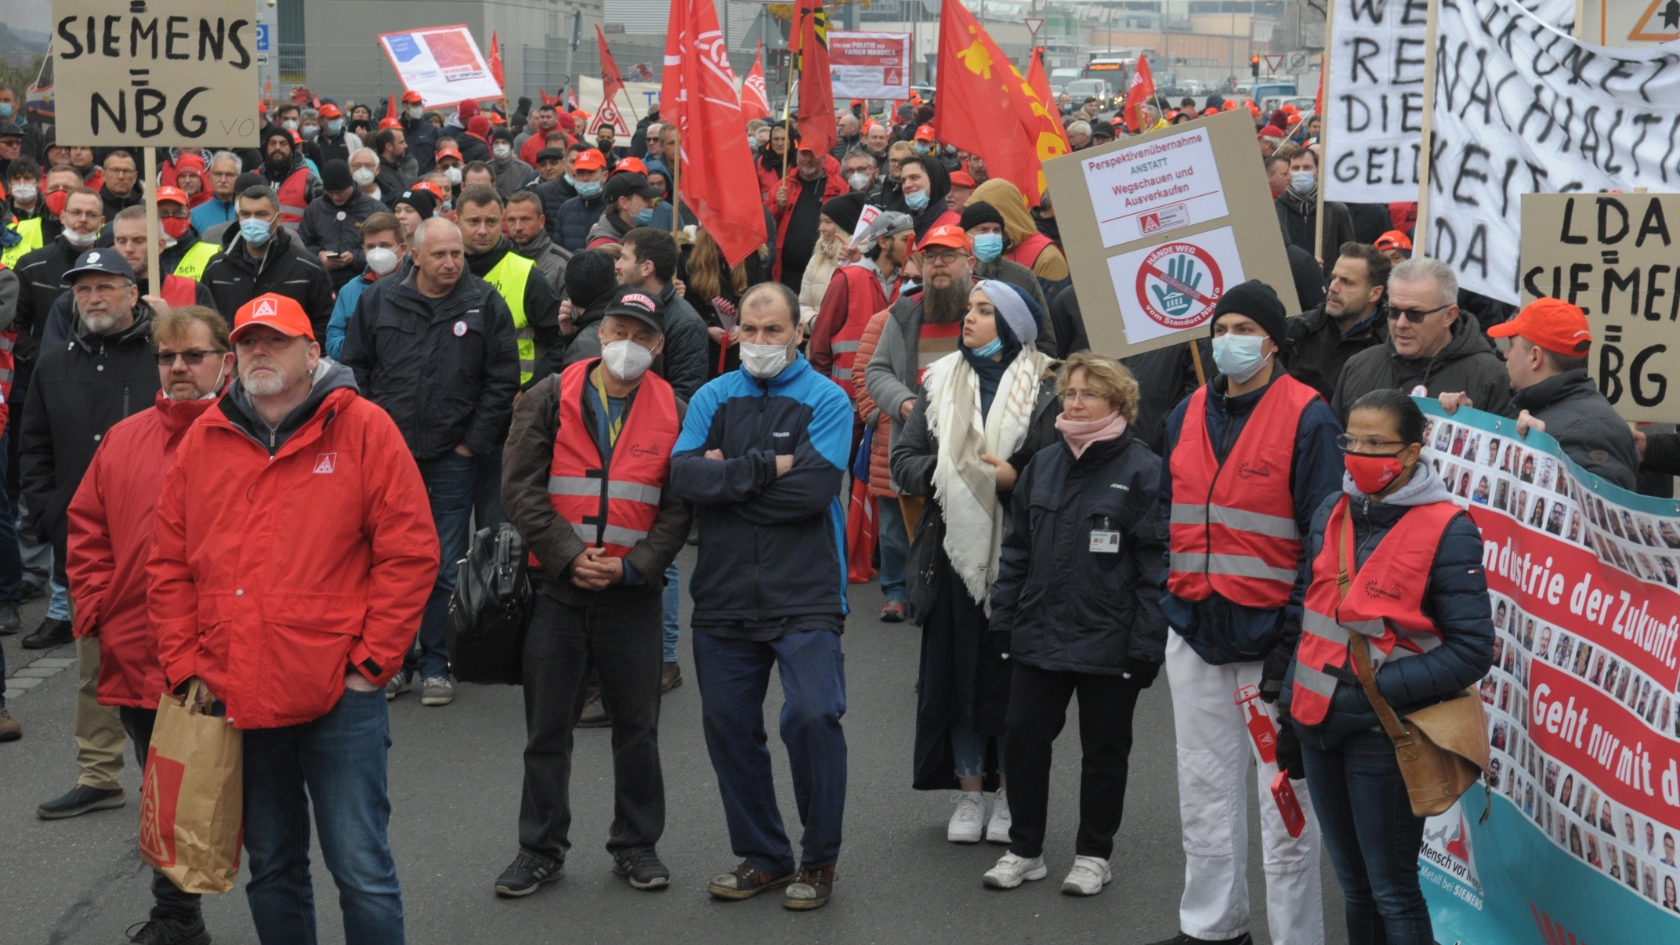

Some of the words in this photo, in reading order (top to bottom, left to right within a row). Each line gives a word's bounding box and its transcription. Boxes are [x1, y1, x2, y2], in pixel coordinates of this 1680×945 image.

[58, 15, 252, 70] SIEMENS
[852, 41, 876, 49] POLITIK
[90, 86, 214, 138] NBG
[1340, 93, 1423, 132] DIE
[1088, 134, 1203, 172] Perspektivenübernahme
[1130, 157, 1168, 175] ANSTATT
[1112, 173, 1174, 196] Wegschauen
[1175, 165, 1194, 179] und
[1125, 184, 1190, 207] Ausverkaufen
[1560, 197, 1671, 247] LDA
[1146, 245, 1174, 265] HÄNDE
[1175, 244, 1196, 254] WEG
[1524, 263, 1680, 323] SIEME
[1146, 304, 1163, 321] vom
[1163, 314, 1202, 326] Standort
[1586, 343, 1667, 407] BG
[1570, 572, 1613, 625] der
[1612, 590, 1680, 670] Zukunft.
[1532, 683, 1588, 749] Geht
[1587, 724, 1619, 771] nur
[1616, 741, 1655, 796] mit
[1420, 841, 1452, 869] Mensch
[1452, 861, 1467, 877] vor
[1420, 865, 1443, 886] Metall
[1442, 878, 1455, 892] bei
[1453, 884, 1484, 911] SIEMENS
